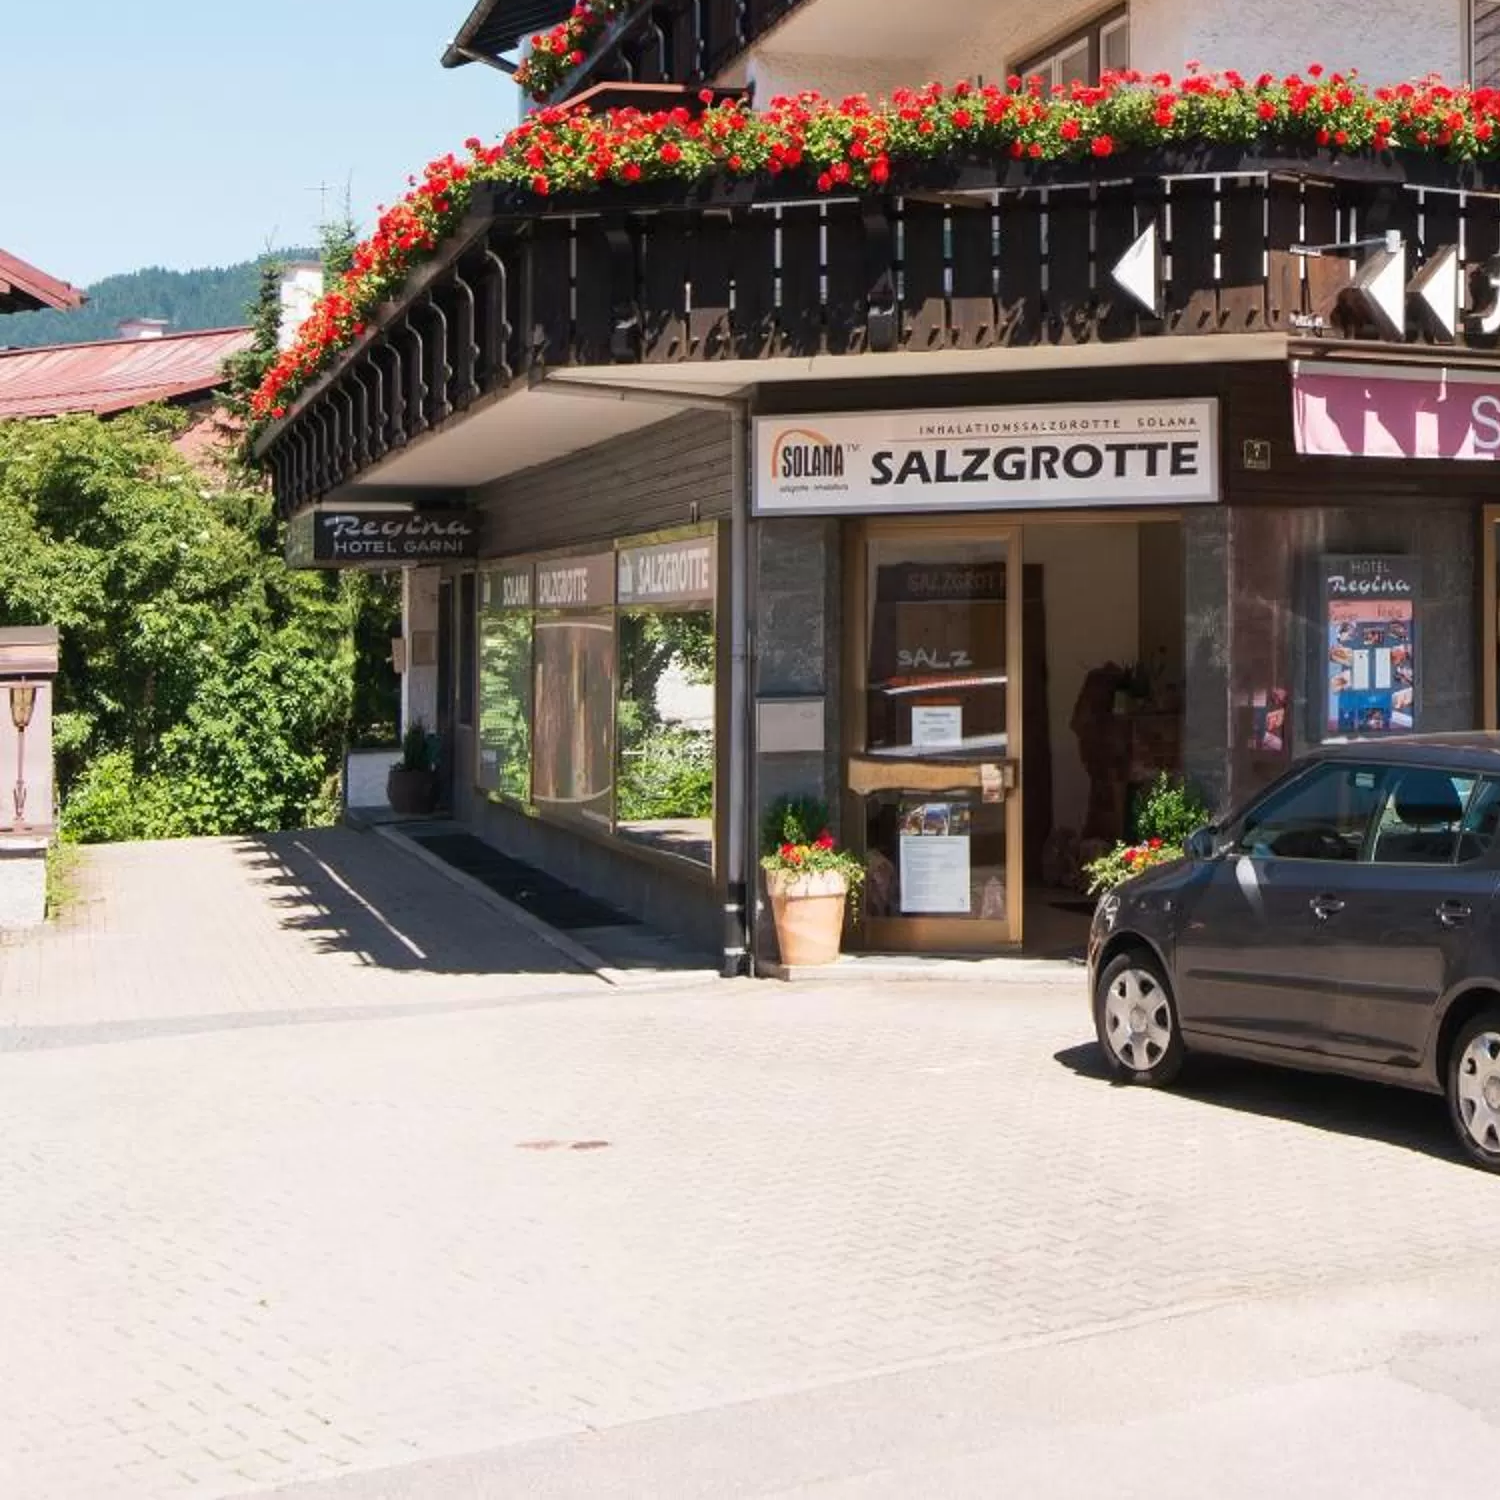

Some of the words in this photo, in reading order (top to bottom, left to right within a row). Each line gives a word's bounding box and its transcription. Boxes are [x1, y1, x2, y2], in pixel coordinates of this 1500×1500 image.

[918, 418, 1121, 436] INHALATIONSSALZGROTTE
[1137, 416, 1198, 428] SOLANA
[782, 443, 845, 478] SOLANA
[870, 440, 1200, 486] SALZGROTTE
[323, 514, 474, 539] Regina
[335, 539, 397, 554] HOTEL
[403, 539, 464, 554] GARNI
[637, 547, 711, 596] SALZGROTTE
[1351, 560, 1392, 574] HOTEL
[1327, 574, 1411, 595] Regina
[897, 646, 973, 668] SALZ
